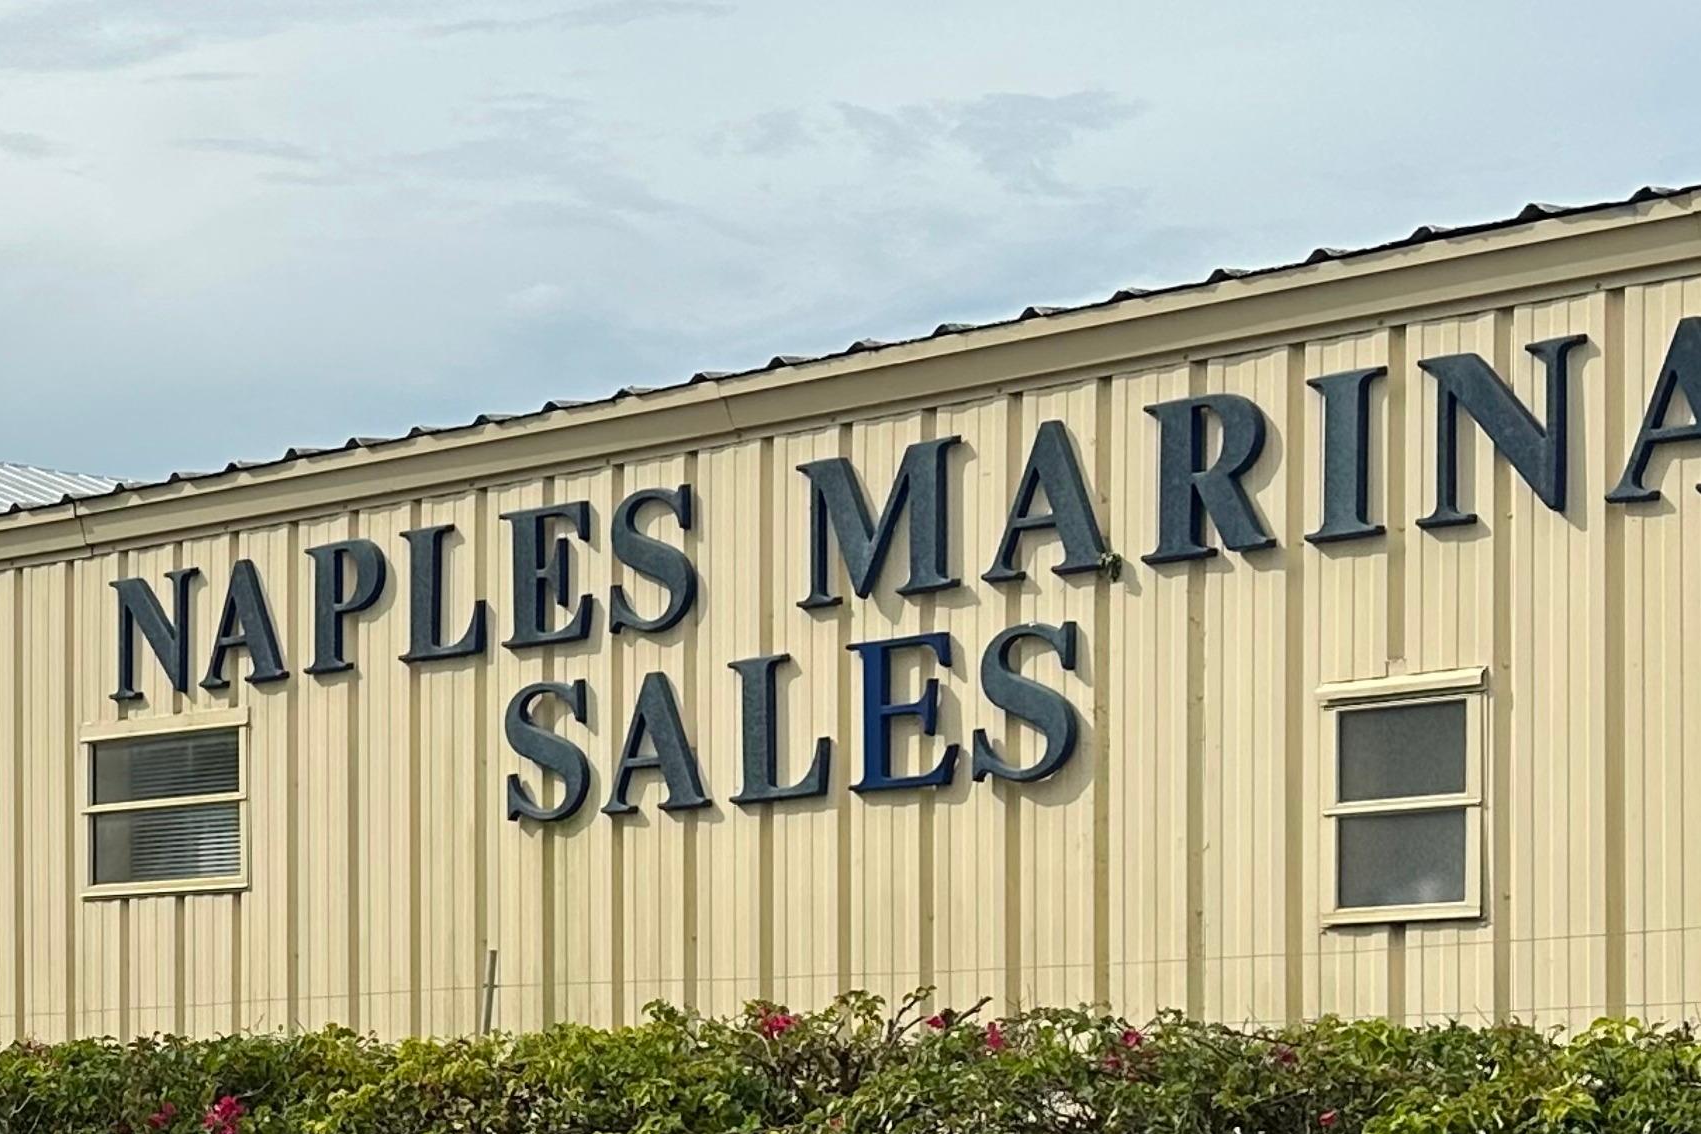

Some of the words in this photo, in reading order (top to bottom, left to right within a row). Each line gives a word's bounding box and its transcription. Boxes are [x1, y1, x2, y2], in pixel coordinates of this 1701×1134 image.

[109, 484, 698, 701] NAPLES
[795, 316, 1701, 610] MARINA
[504, 620, 1079, 823] SALES
